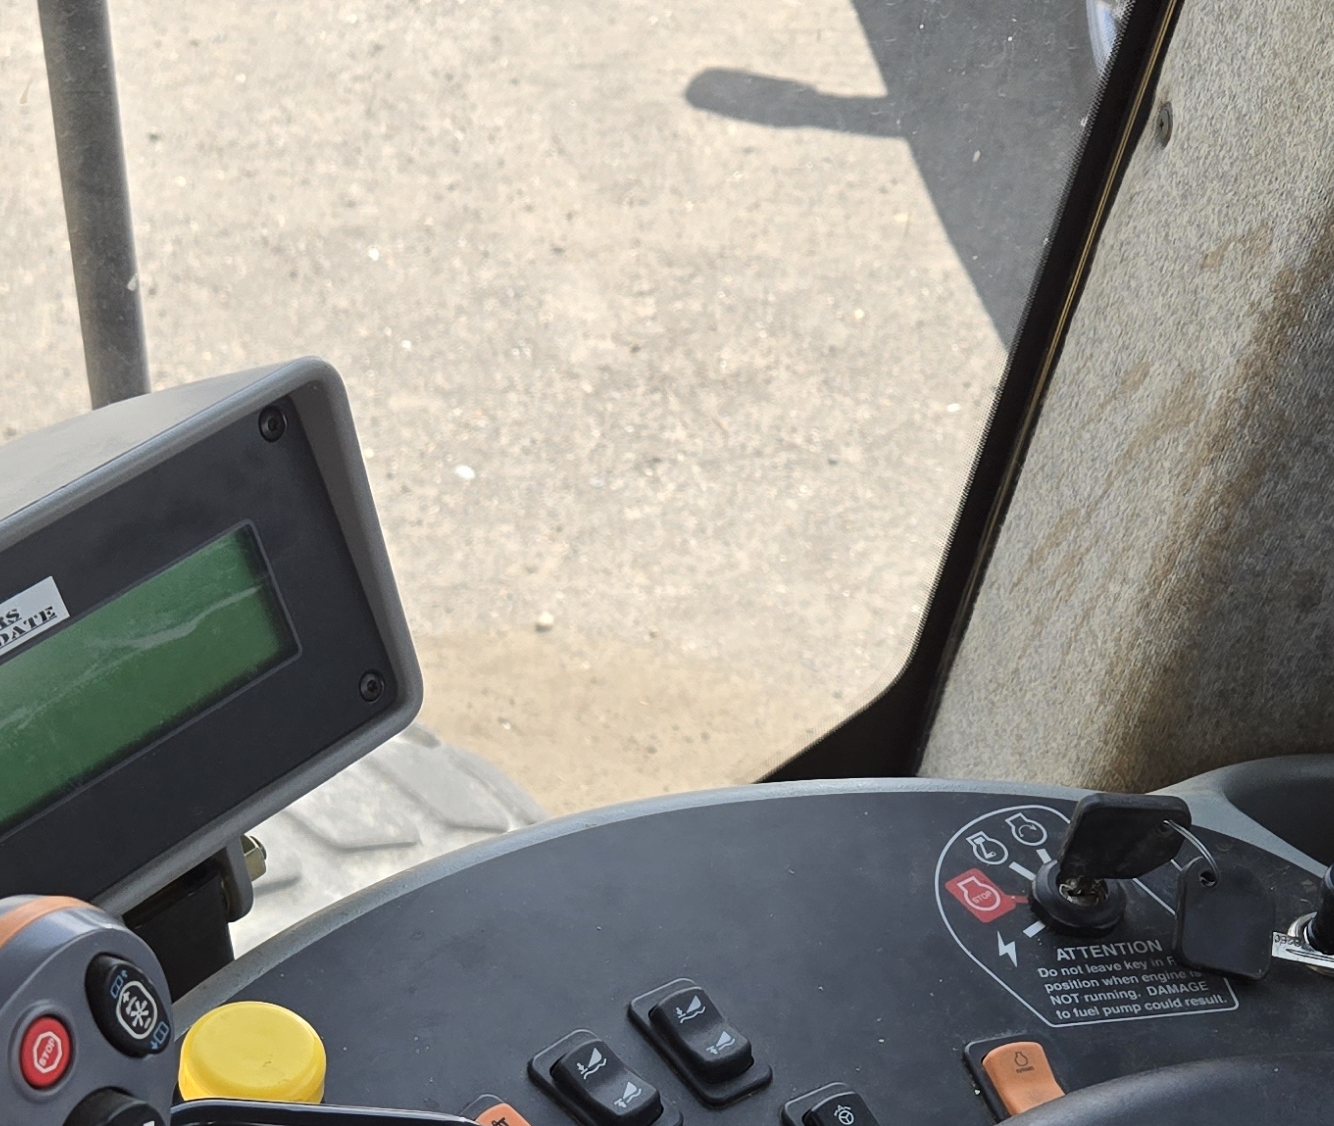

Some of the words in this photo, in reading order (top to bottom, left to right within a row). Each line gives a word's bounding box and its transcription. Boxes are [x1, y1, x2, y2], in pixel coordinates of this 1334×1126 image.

[1056, 939, 1163, 962] ATTENTION
[1037, 966, 1058, 978] Do
[1061, 964, 1084, 976] not
[1086, 960, 1121, 974] leave
[1124, 957, 1149, 972] key
[1151, 957, 1165, 967] in
[1044, 977, 1101, 994] position
[1101, 973, 1140, 987] when
[1141, 968, 1187, 984] engine
[1050, 992, 1080, 1006] NOT
[1084, 987, 1142, 1003] running.
[1146, 980, 1210, 998] DAMAGE
[1056, 1007, 1071, 1020] to
[1072, 1004, 1101, 1017] fuel
[1103, 1001, 1143, 1017] pump
[1145, 996, 1183, 1011] could
[1184, 992, 1228, 1009] result.
[38, 1037, 55, 1067] STOP
